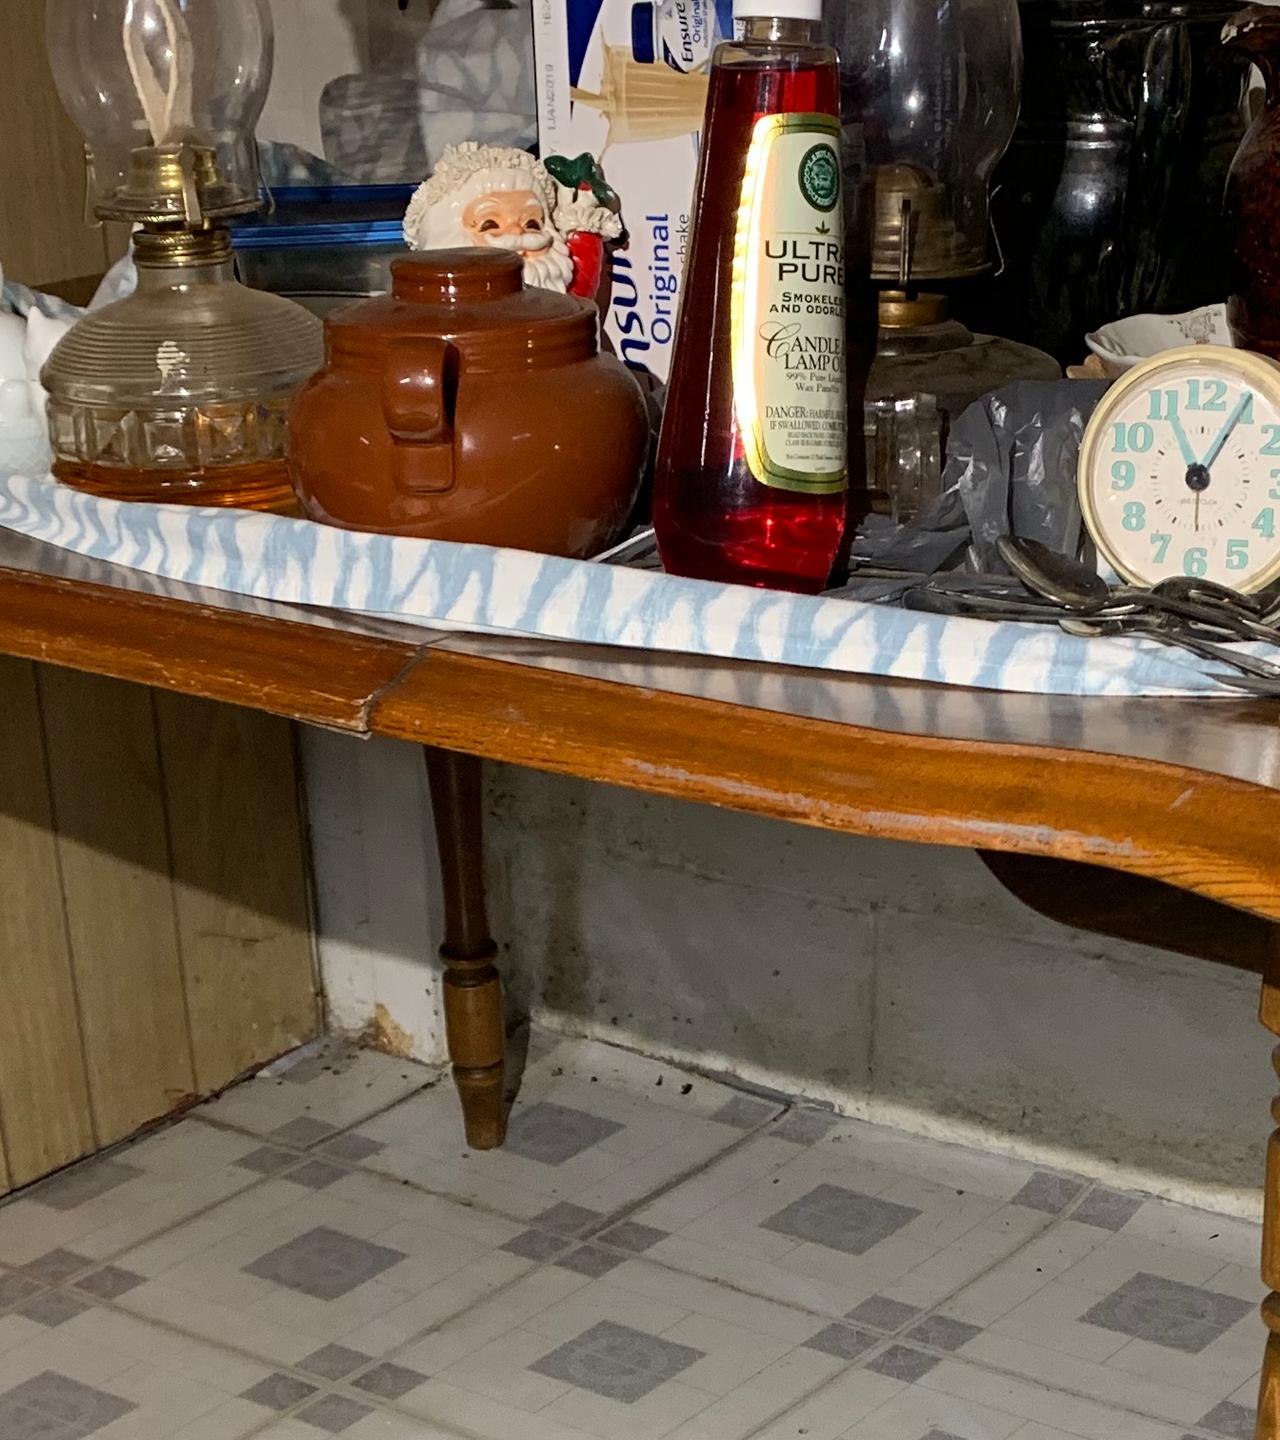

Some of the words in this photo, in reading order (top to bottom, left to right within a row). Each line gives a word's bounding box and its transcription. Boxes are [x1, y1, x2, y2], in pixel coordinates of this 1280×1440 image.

[675, 2, 693, 62] Ensure
[646, 213, 677, 344] Original
[779, 263, 844, 287] PURE
[607, 255, 650, 373] nsur
[769, 304, 801, 314] AND
[759, 321, 841, 362] CANDLE
[784, 353, 830, 371] LAMP
[1146, 389, 1180, 421] 11
[1185, 379, 1228, 411] 12
[1111, 422, 1154, 453] 10
[1111, 460, 1136, 491] 9
[1122, 501, 1146, 532] 8
[1251, 507, 1275, 538] 4
[1150, 533, 1172, 563] 7
[1183, 547, 1208, 577] 6
[1225, 539, 1249, 569] 5
